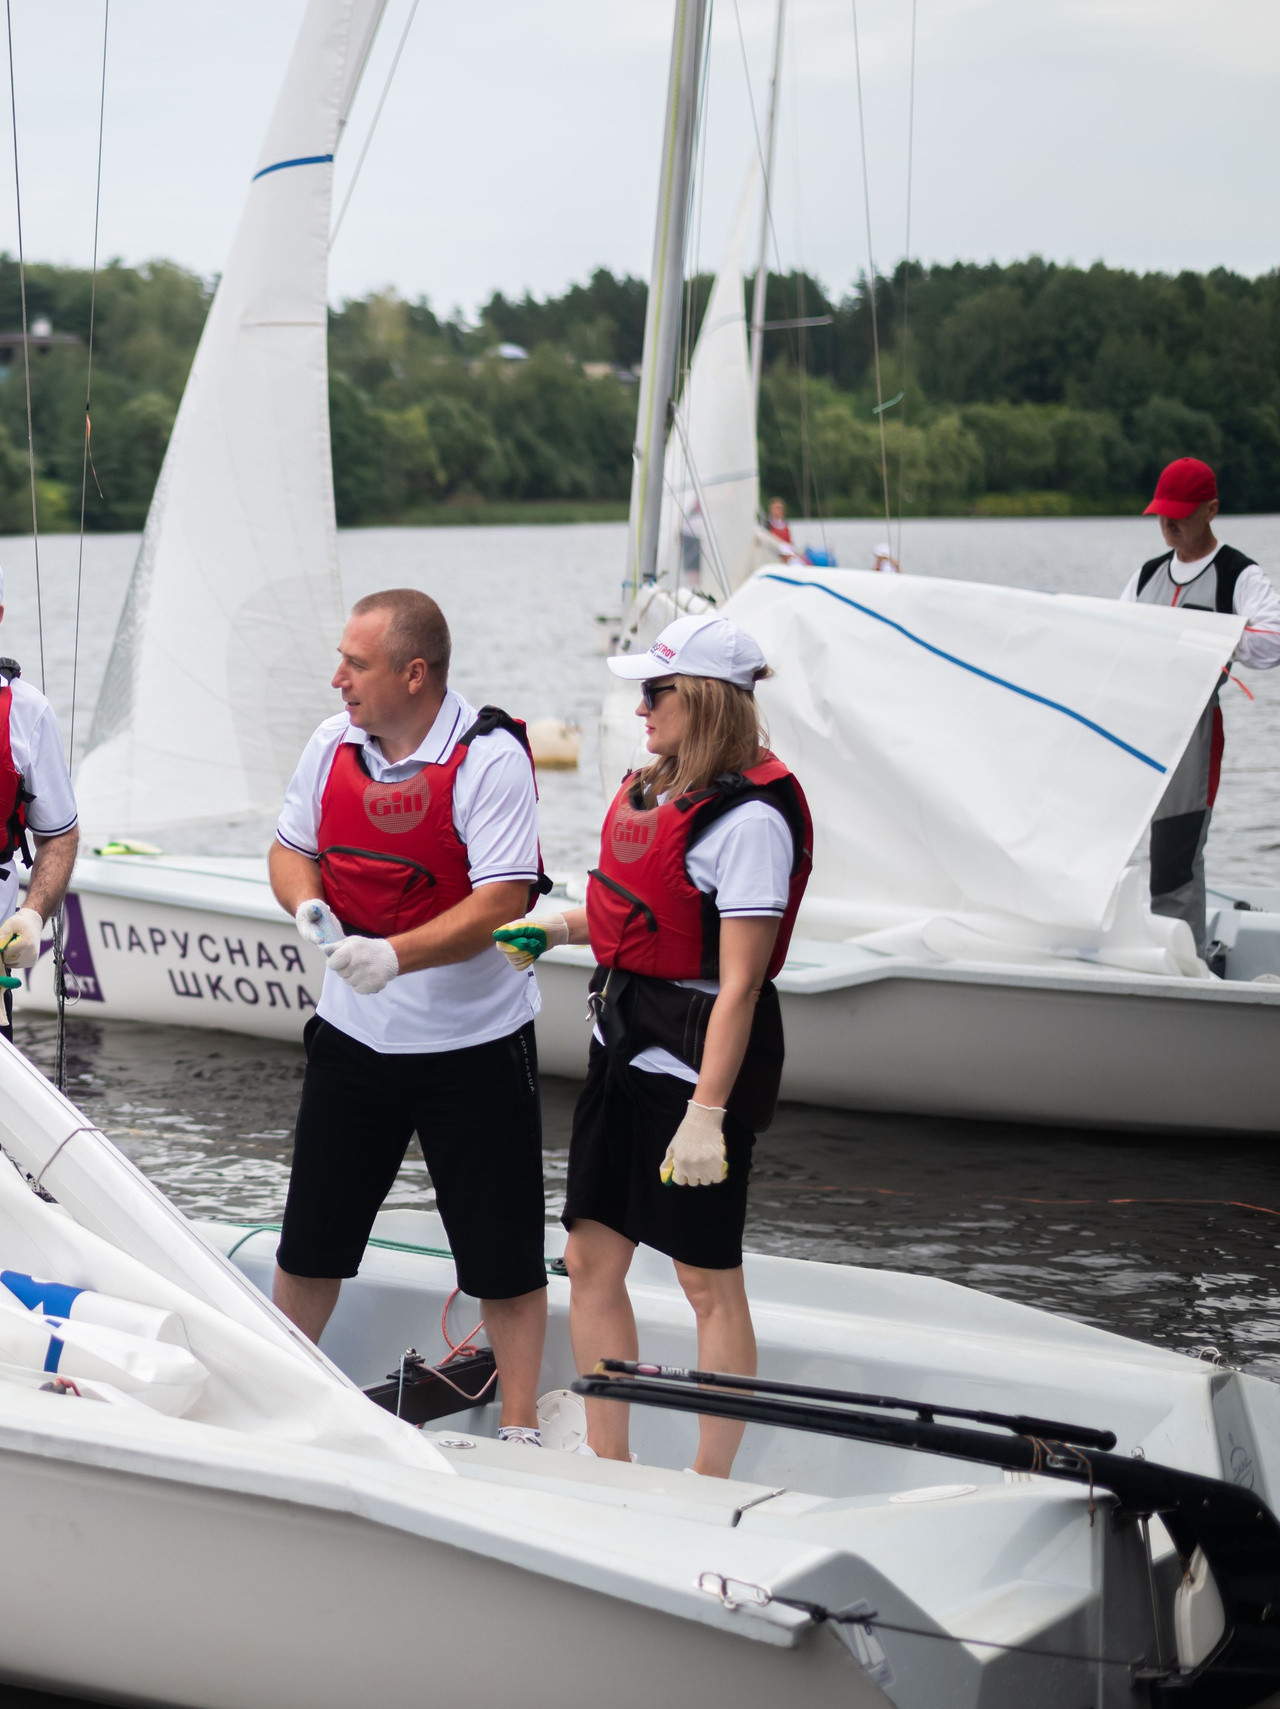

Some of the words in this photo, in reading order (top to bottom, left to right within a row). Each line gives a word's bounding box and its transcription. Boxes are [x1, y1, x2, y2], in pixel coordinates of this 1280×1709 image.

[369, 791, 423, 816] Gill
[614, 819, 650, 845] Gill
[99, 920, 306, 974] ПАРУСНАЯ
[168, 969, 319, 1012] ШКОЛА
